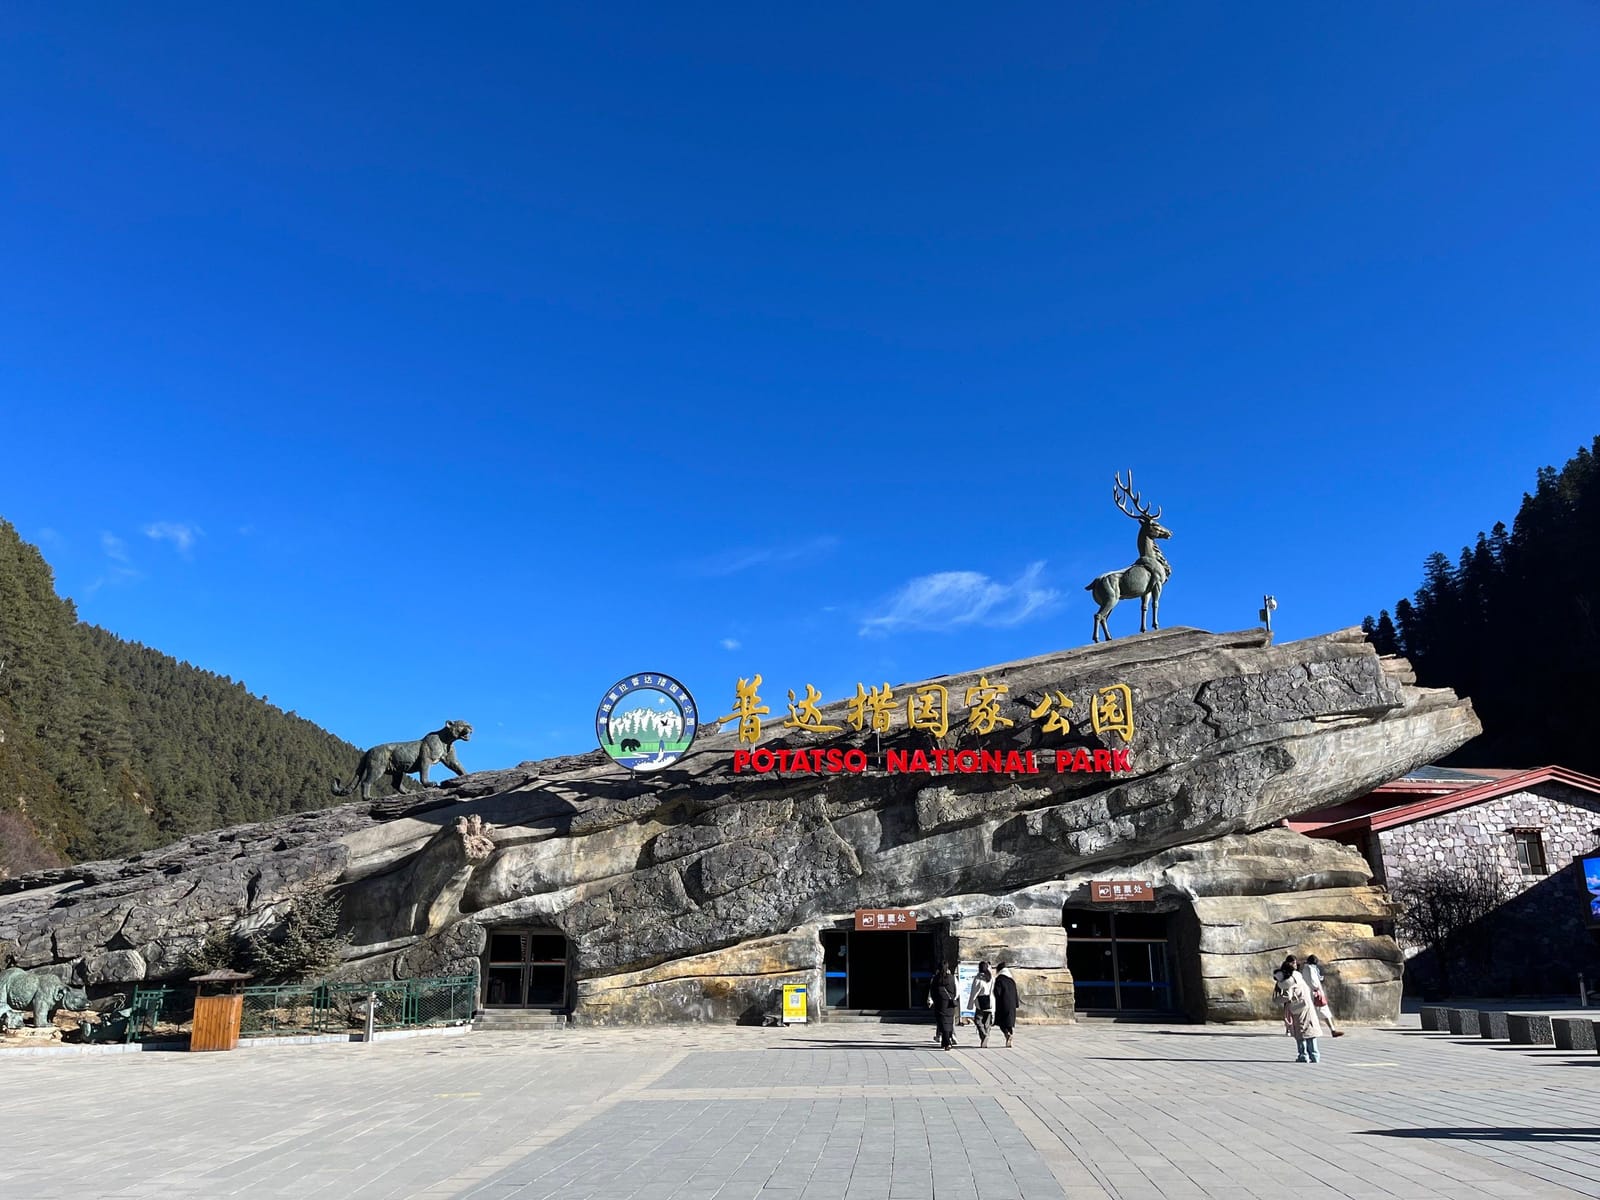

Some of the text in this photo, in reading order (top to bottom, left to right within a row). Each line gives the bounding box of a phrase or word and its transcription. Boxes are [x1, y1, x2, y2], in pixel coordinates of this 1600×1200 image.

[719, 673, 1134, 744] 普达措国家公园
[733, 748, 1132, 773] POTATSO NATIONAL PARK
